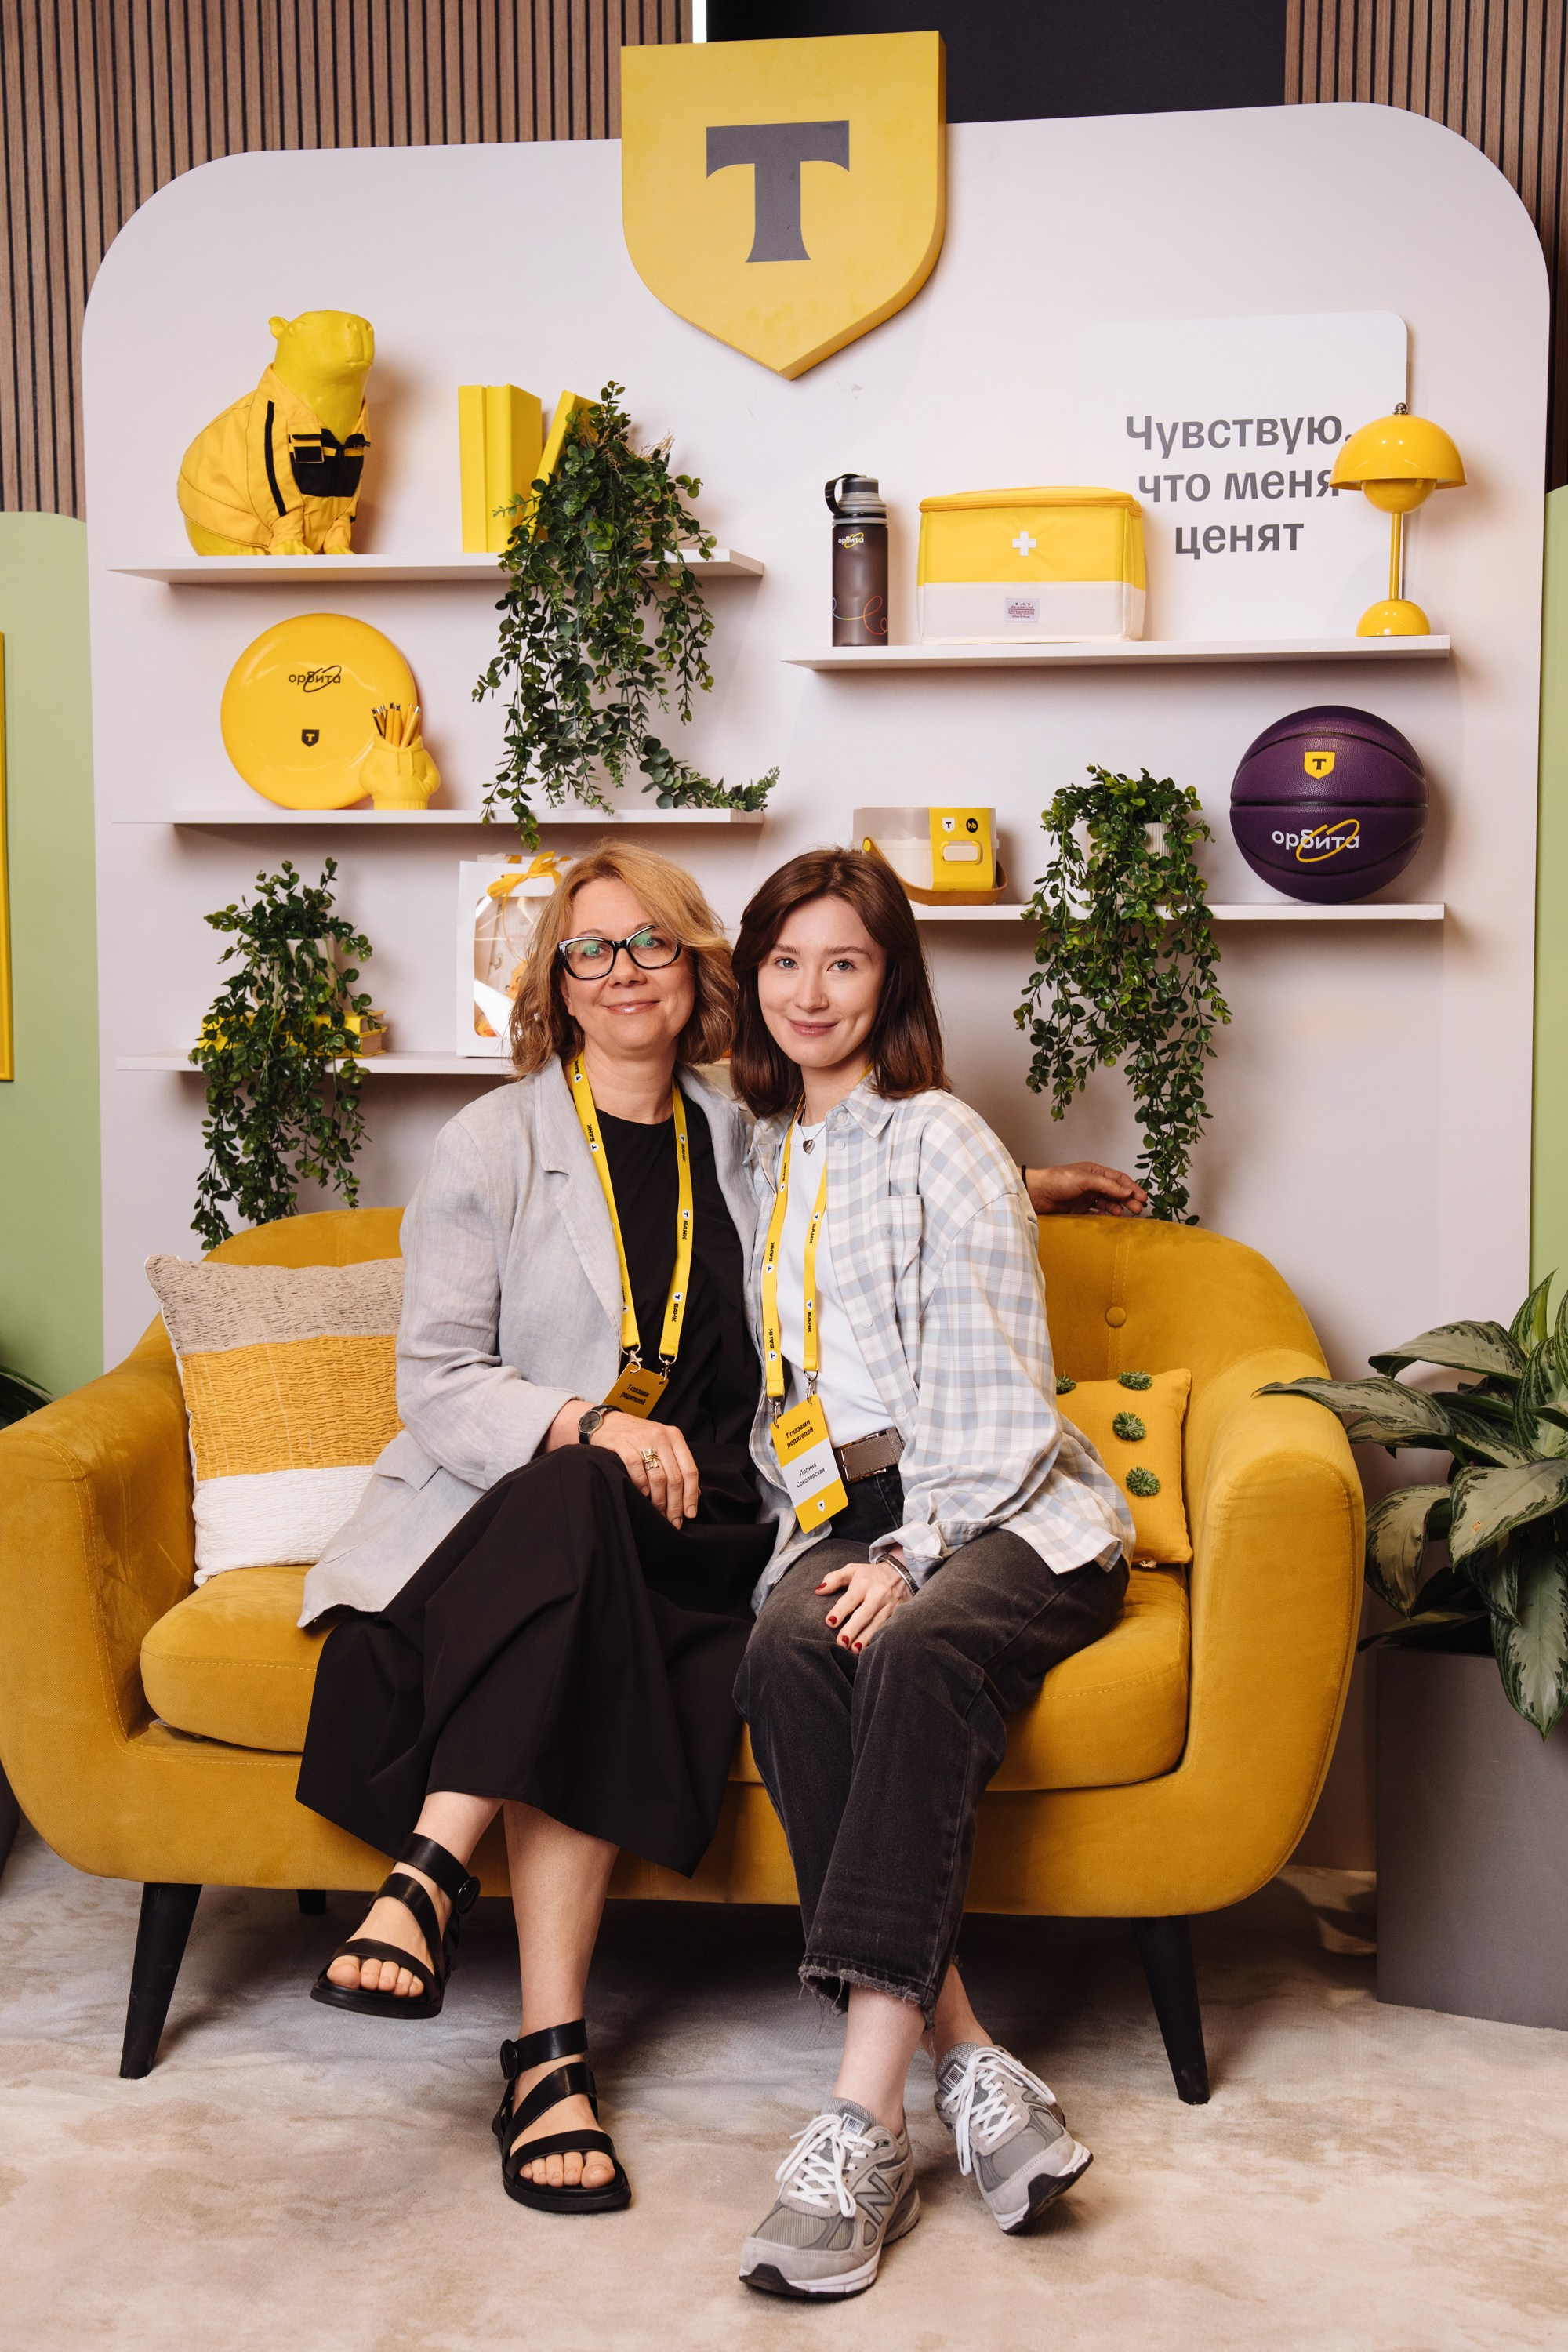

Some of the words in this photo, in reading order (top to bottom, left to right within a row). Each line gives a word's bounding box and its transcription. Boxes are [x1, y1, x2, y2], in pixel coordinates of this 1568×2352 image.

[706, 120, 850, 263] Т
[1138, 473, 1210, 503] что
[1224, 469, 1339, 500] меня
[837, 535, 865, 545] орбита
[1175, 523, 1304, 560] ценят
[289, 671, 341, 686] орбита
[1312, 758, 1327, 770] Т
[1272, 829, 1359, 850] орбита
[586, 1123, 595, 1142] БАНК
[619, 1392, 647, 1406] родителей
[630, 1386, 650, 1397] глазами
[789, 1419, 811, 1437] глазами
[786, 1426, 814, 1450] родителей
[796, 1468, 826, 1488] Соколовская
[799, 1462, 817, 1477] Полина
